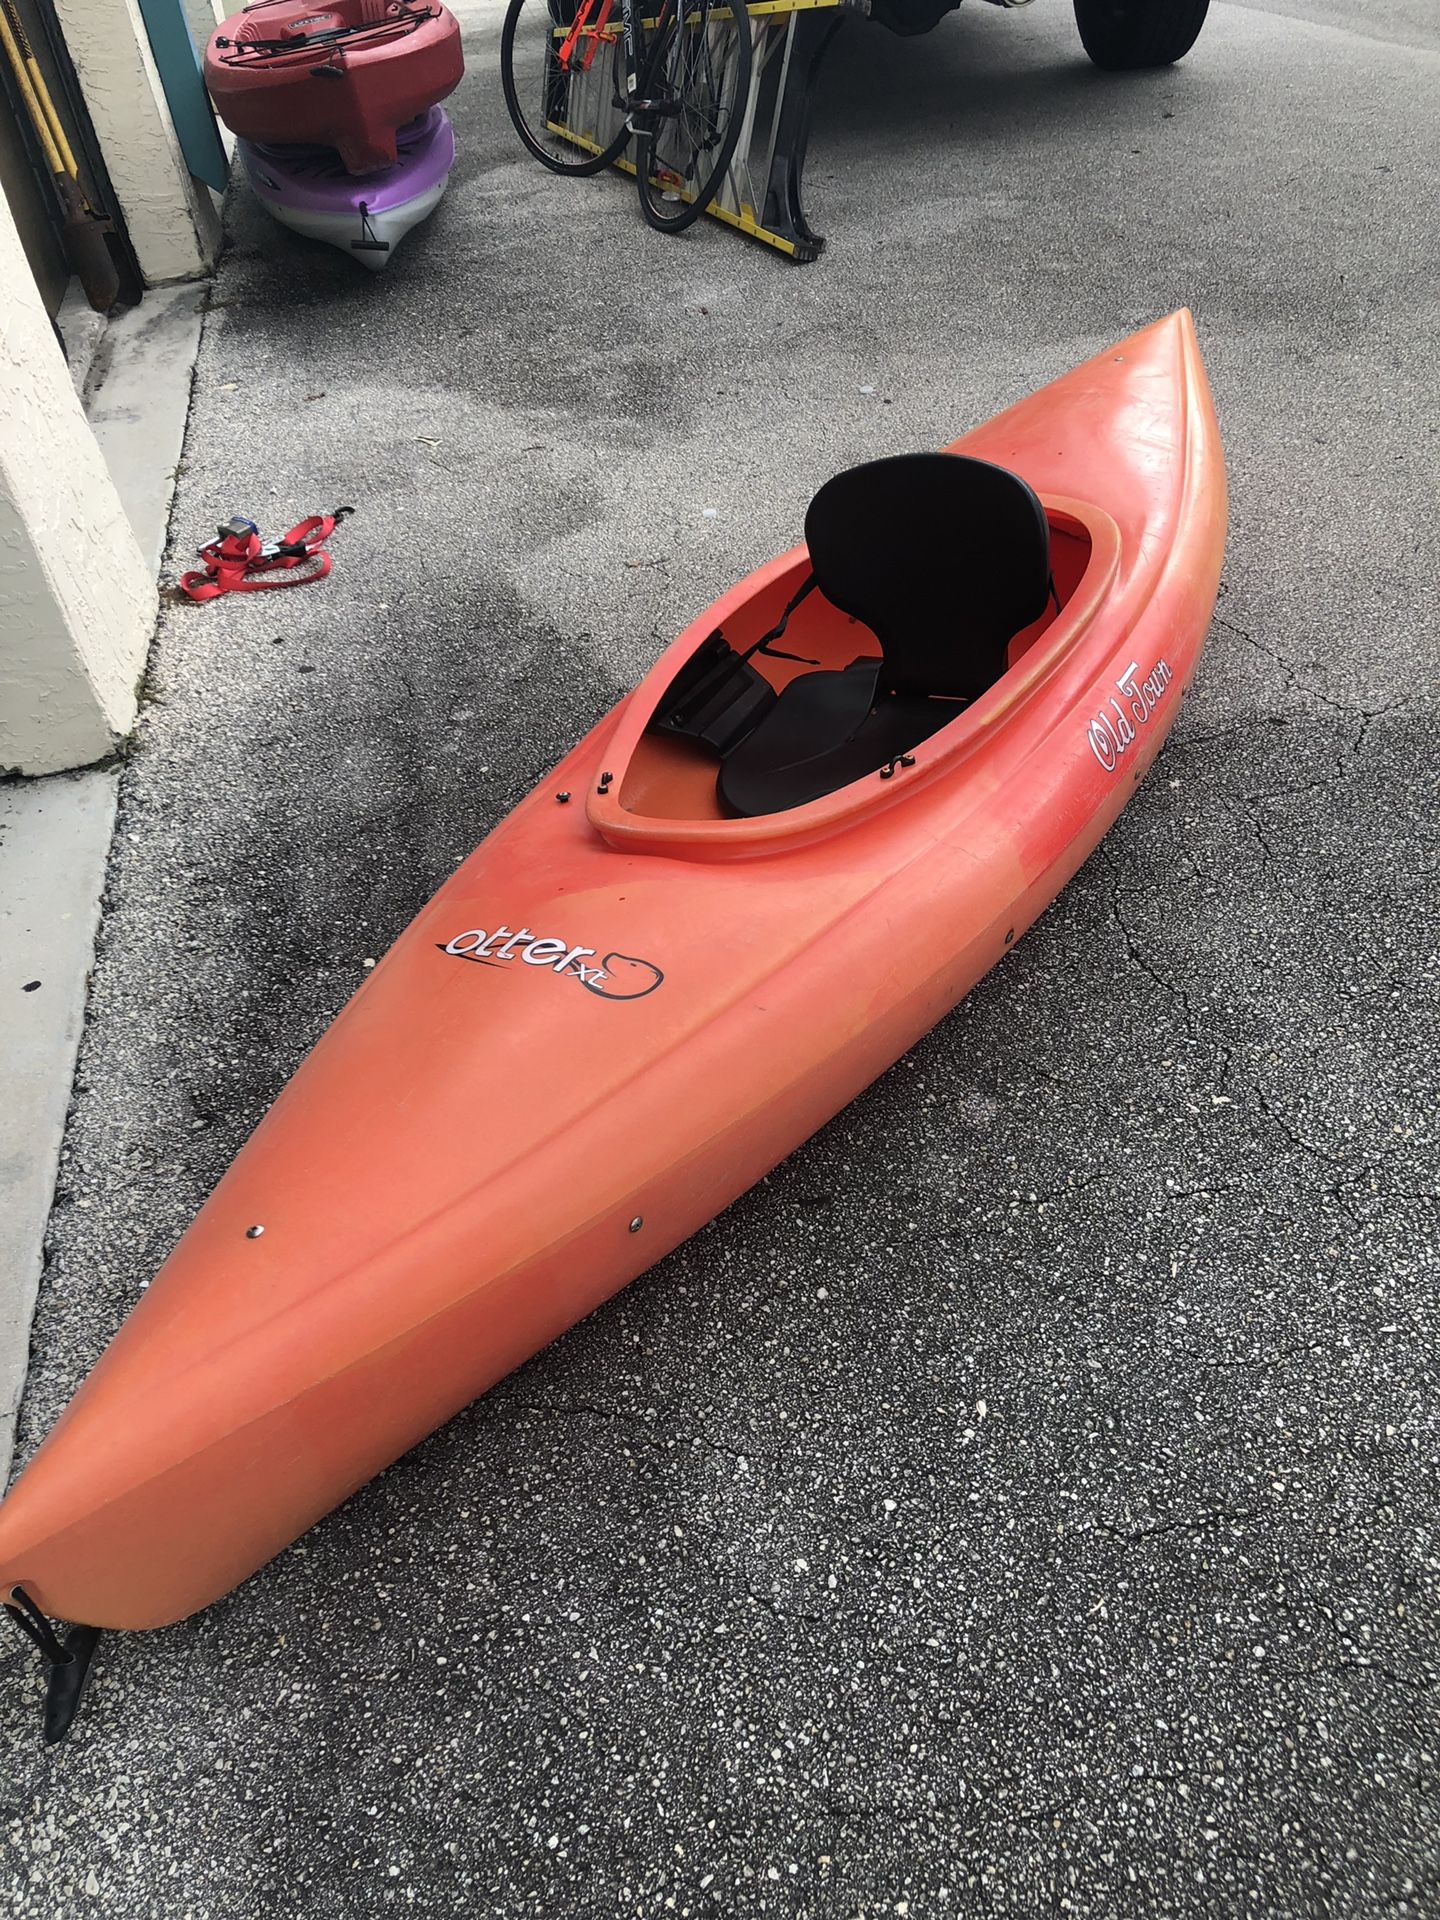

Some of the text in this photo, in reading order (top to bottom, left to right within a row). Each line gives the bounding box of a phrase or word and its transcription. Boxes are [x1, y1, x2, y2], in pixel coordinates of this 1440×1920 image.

[1087, 658, 1173, 772] Old Town
[444, 925, 596, 973] otter
